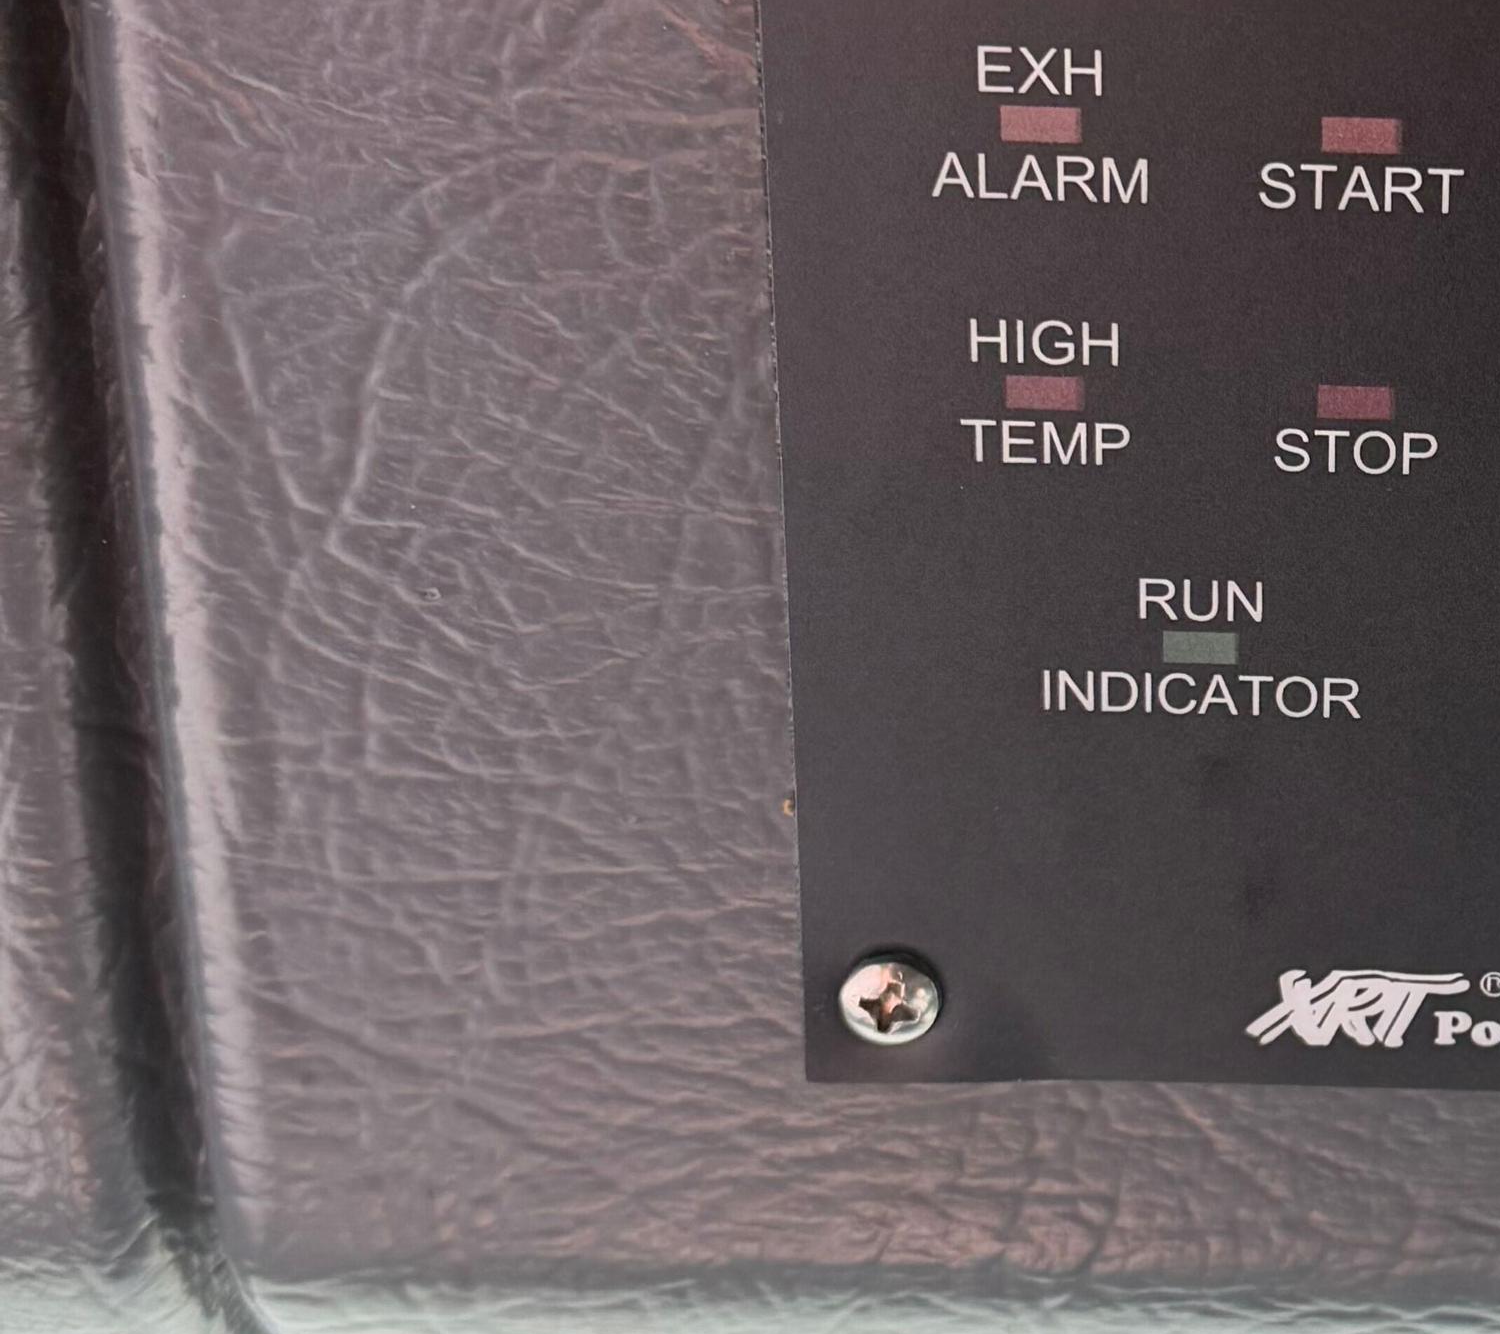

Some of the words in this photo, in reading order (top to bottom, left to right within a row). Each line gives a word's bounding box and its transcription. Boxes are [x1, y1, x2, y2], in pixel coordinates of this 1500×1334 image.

[977, 45, 1103, 97] EXH
[932, 151, 1149, 205] ALARM
[1259, 162, 1465, 214] START
[969, 318, 1120, 367] HIGH
[960, 418, 1131, 466] TEMP
[1274, 428, 1439, 476] STOP
[1138, 577, 1265, 623] RUN
[1042, 669, 1362, 720] INDICATOR
